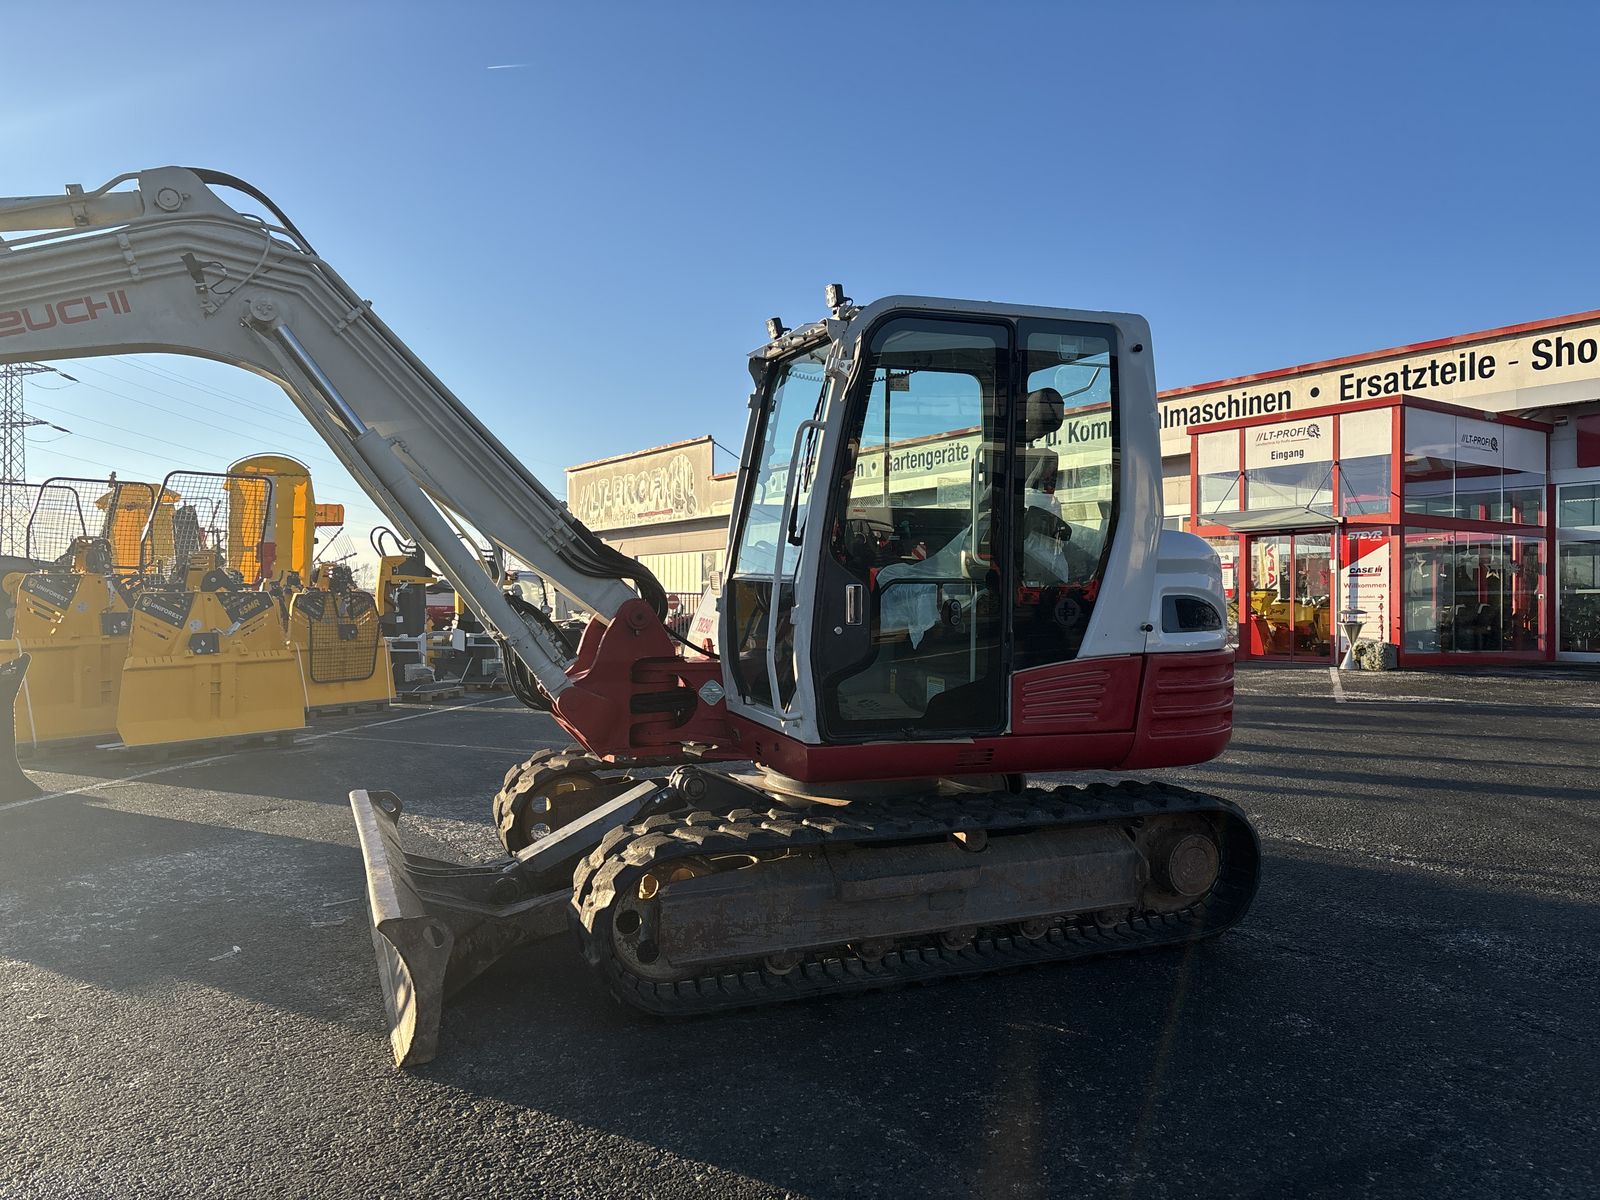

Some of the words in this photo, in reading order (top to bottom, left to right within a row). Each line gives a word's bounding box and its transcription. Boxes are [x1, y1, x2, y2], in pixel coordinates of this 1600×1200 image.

[1339, 352, 1496, 401] Ersatzteile
[1531, 336, 1598, 371] Sho
[1271, 449, 1304, 460] Eingang
[1347, 530, 1383, 540] STEYR
[36, 583, 68, 603] UNIFOREST
[151, 602, 184, 620] UNIFOREST
